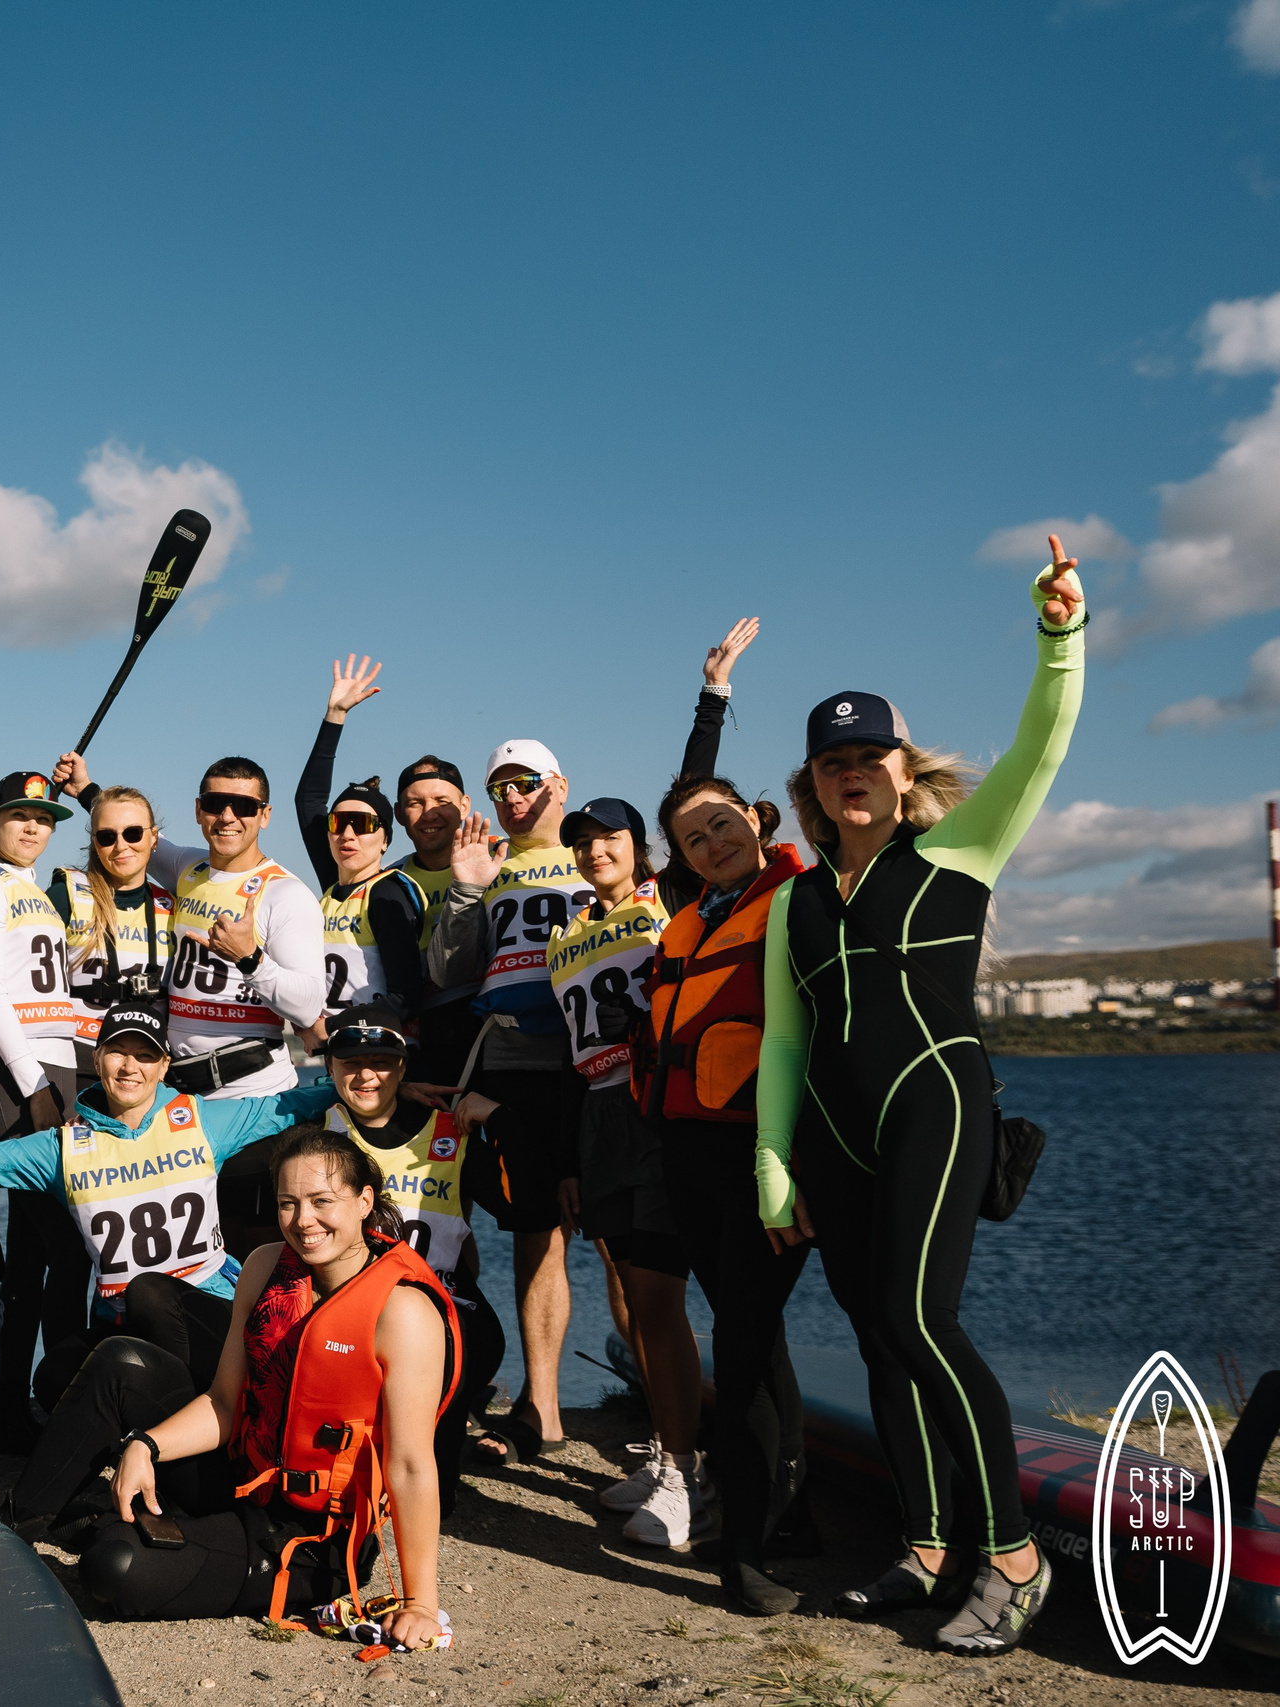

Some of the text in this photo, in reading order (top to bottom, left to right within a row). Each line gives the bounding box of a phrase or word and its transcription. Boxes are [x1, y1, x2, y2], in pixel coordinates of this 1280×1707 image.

[488, 863, 580, 890] УРМАН
[324, 915, 362, 934] НСК
[31, 934, 68, 994] 31
[173, 935, 228, 995] 05
[112, 1011, 161, 1029] VOLVO
[170, 1000, 246, 1019] ORSPORT51.RU
[70, 1146, 206, 1192] МУРМАНСК
[383, 1174, 453, 1200] АНСК
[90, 1191, 208, 1275] 282
